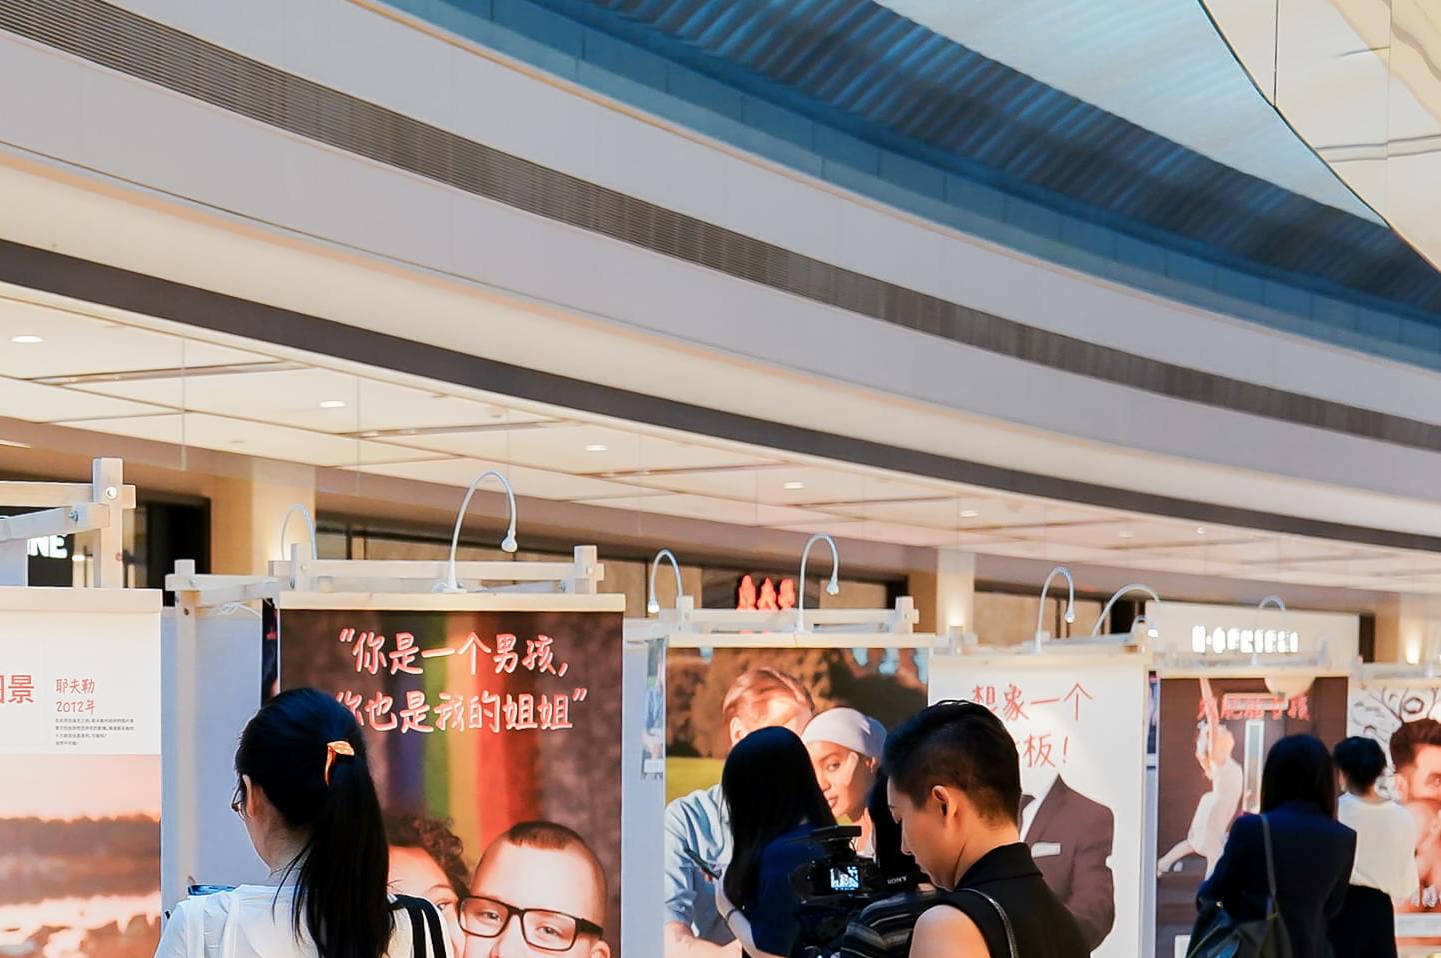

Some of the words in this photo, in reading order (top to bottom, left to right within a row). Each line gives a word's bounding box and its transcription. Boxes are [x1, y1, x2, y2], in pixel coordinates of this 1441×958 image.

[55, 677, 96, 695] 耶夫勒
[55, 700, 96, 715] 2012年
[971, 681, 1093, 721] 想象一个
[1016, 733, 1069, 769] 板！
